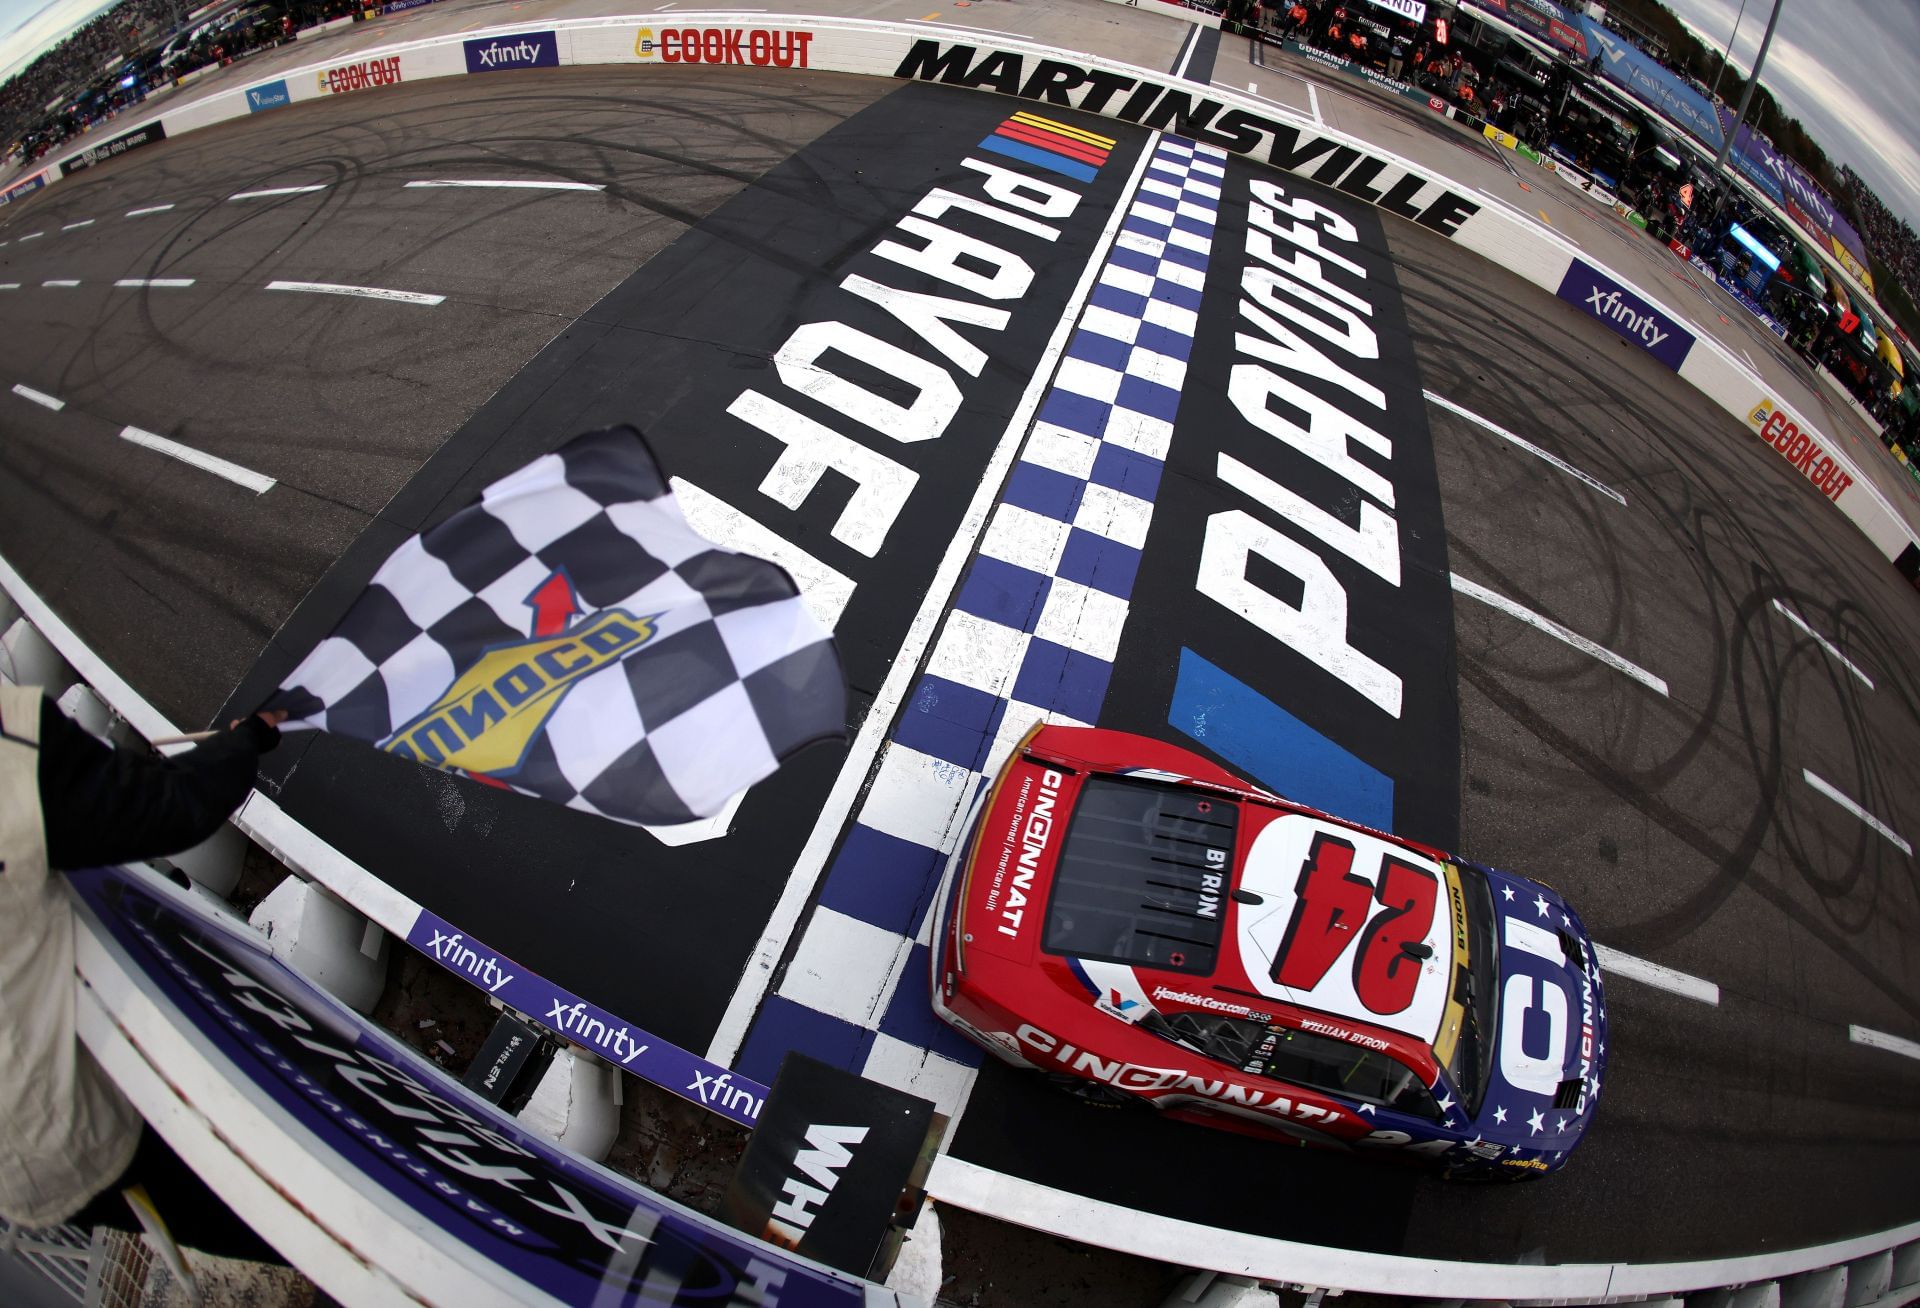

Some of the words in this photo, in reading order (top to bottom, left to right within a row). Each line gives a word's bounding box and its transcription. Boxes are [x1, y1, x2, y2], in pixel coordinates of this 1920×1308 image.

[328, 62, 371, 94] COOK
[370, 56, 402, 86] OUT
[479, 40, 541, 66] xfinity
[660, 28, 744, 65] COOK
[749, 31, 813, 68] OUT
[1306, 54, 1340, 71] MENSWEAR
[1368, 78, 1401, 95] MENSWEAR
[893, 39, 1480, 237] MARTINSVILLE
[1581, 180, 1593, 193] 4
[1760, 148, 1834, 228] xfinity
[1585, 285, 1669, 348] xfinity
[668, 157, 1083, 665] PLAYOF
[1195, 179, 1403, 720] PLAYOFFS
[1760, 411, 1823, 485] COOK
[1810, 456, 1854, 502] OUT
[1013, 776, 1034, 816] American
[997, 769, 1063, 937] CINCINNATI
[1007, 815, 1023, 843] Owned
[993, 846, 1013, 889] American
[1195, 848, 1226, 918] BYRON
[1269, 830, 1439, 1016] 24
[1452, 887, 1466, 950] BYRON
[426, 928, 514, 992] xfinity
[545, 997, 649, 1064] xfinity
[1152, 985, 1251, 1016] HendrickCars.com
[483, 1035, 524, 1090] WHELEN
[1299, 1018, 1350, 1040] WILLIAM
[1349, 1032, 1391, 1051] BYRON
[178, 933, 658, 1255] xfinity
[1015, 1023, 1344, 1126] CINCINNATI
[255, 1042, 525, 1237] MARTINSVILLE
[1501, 1158, 1549, 1171] GOODYEAR
